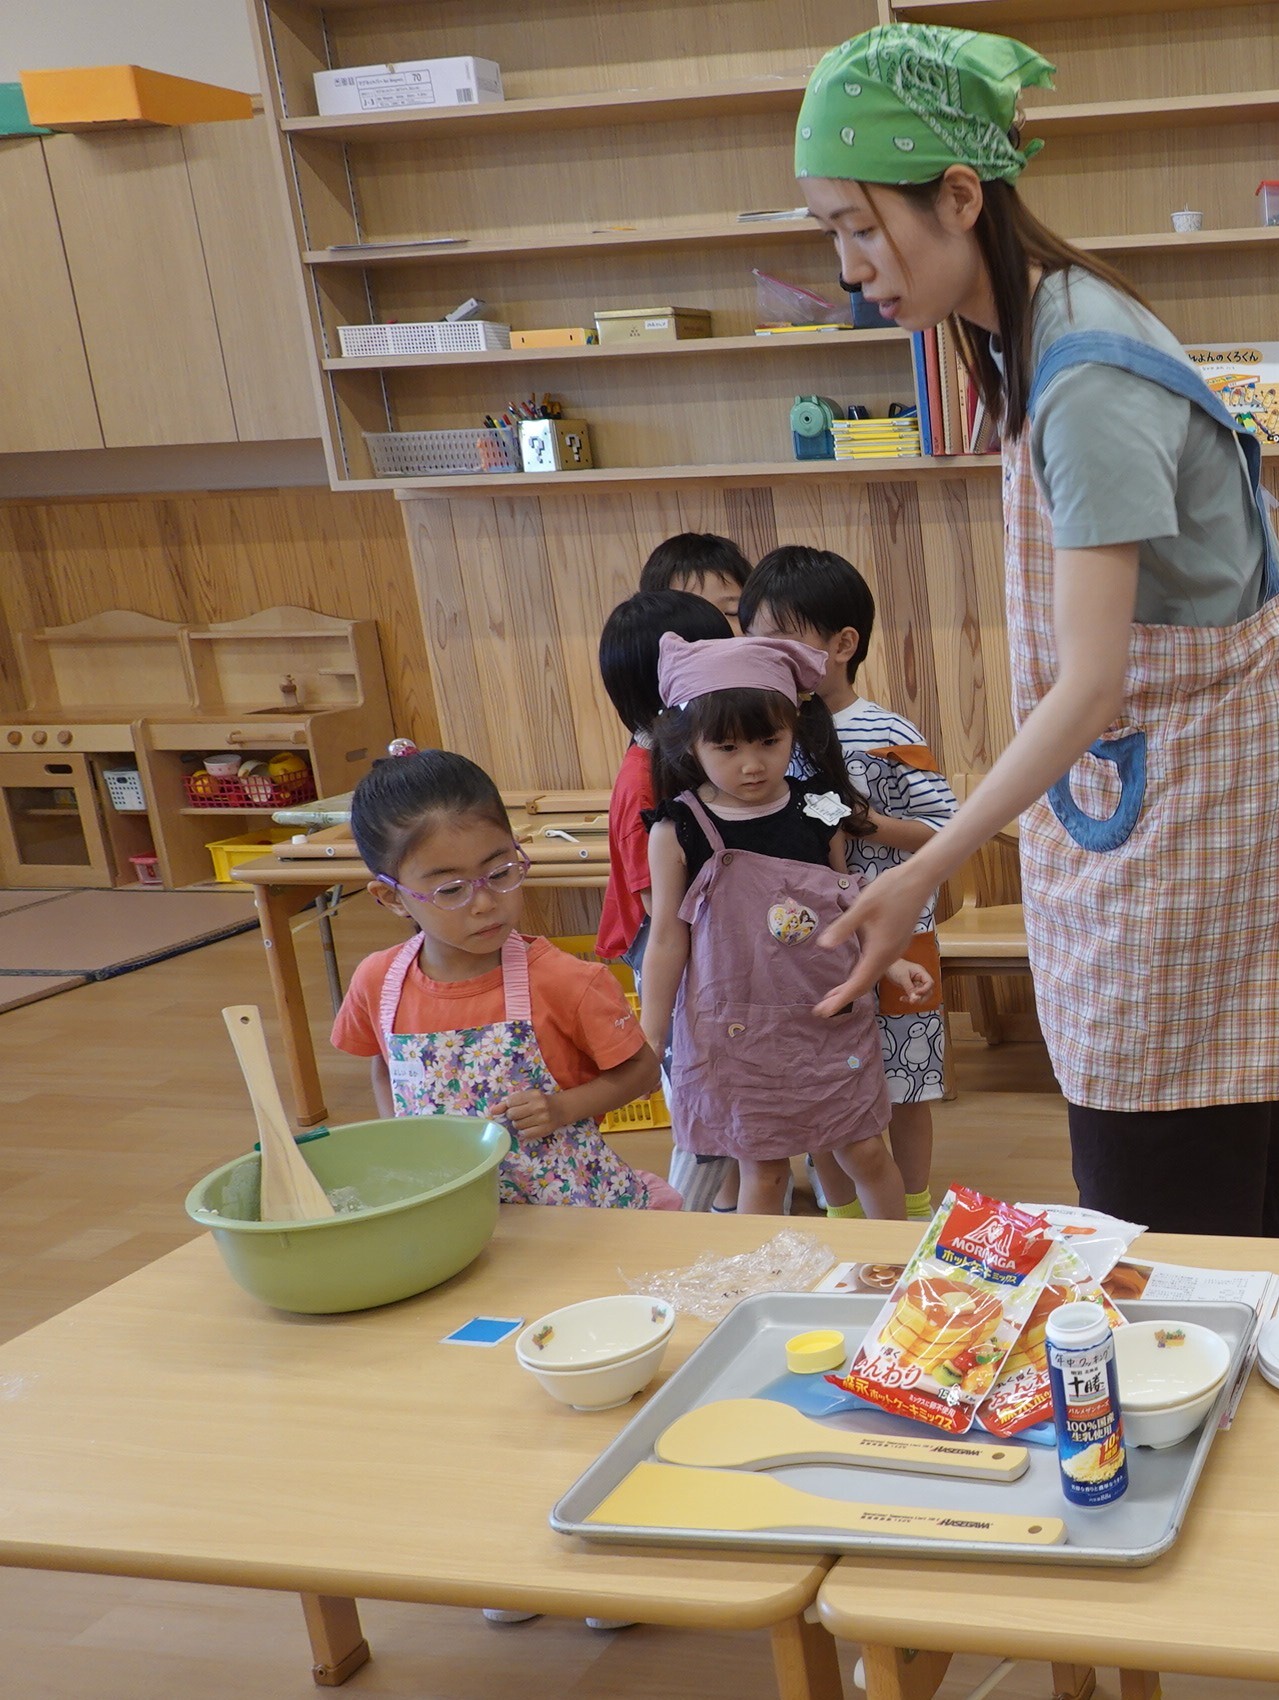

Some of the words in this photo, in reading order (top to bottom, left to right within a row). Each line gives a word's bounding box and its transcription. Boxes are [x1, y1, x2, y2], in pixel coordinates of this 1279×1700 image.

[411, 72, 422, 82] 70
[1068, 1372, 1105, 1398] 十勝
[908, 1394, 957, 1418] ミックスに卵不使用
[1068, 1399, 1111, 1415] パルメザンチーズ
[1066, 1412, 1115, 1432] 100%国産
[1071, 1424, 1112, 1443] 生乳使用
[931, 1446, 980, 1456] HASEGAWA
[937, 1518, 990, 1529] HASEGAWA
